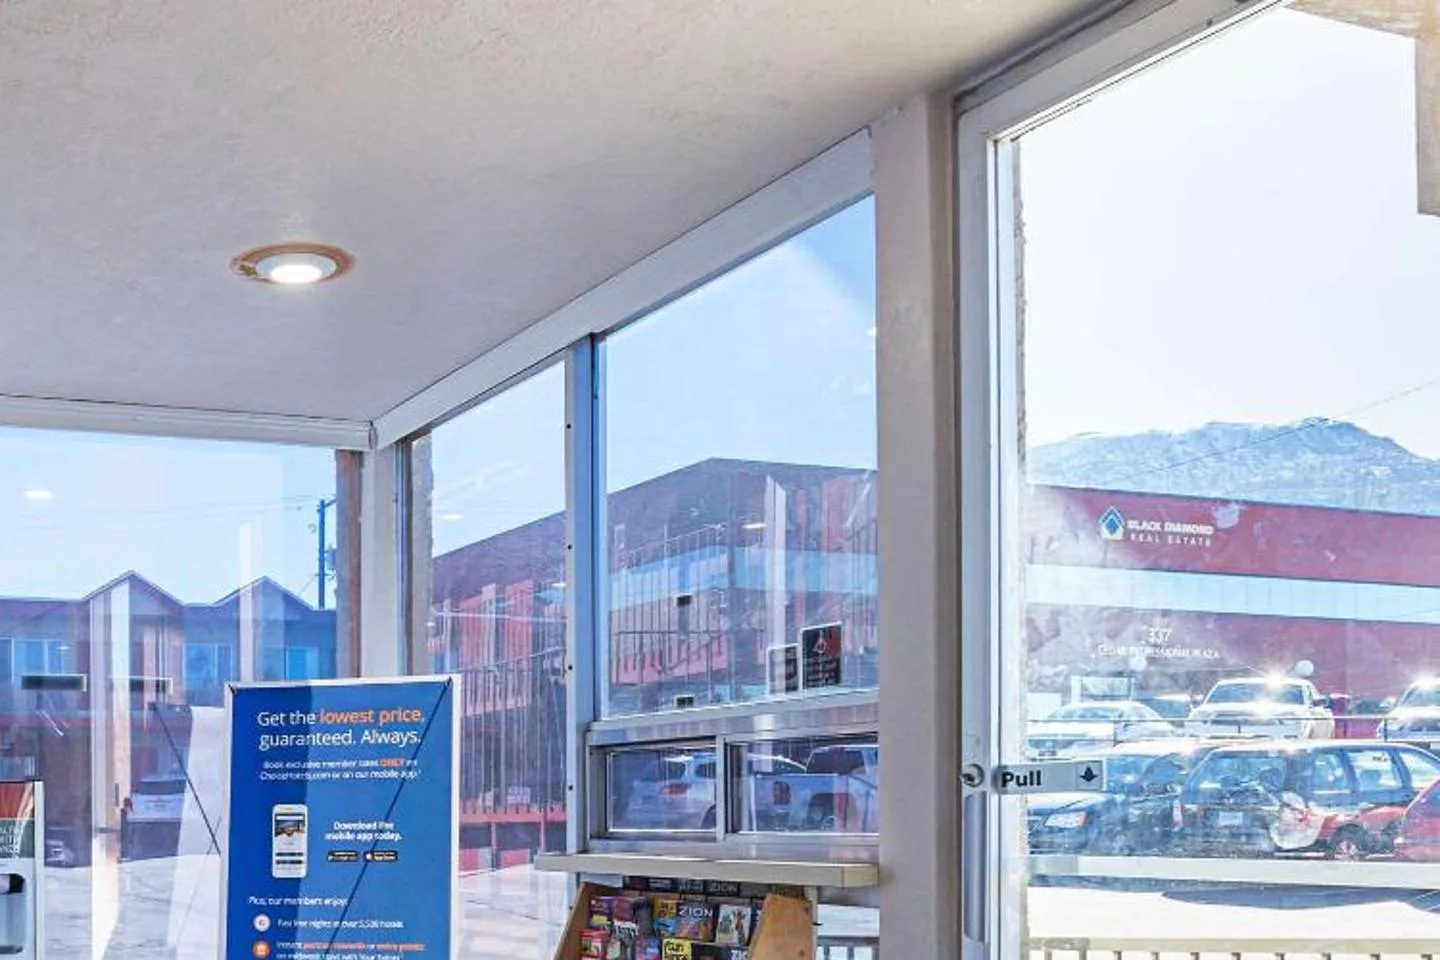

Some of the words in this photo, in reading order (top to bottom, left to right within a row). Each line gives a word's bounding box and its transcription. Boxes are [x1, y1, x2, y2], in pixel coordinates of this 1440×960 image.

[1127, 520, 1162, 531] BLACK
[1164, 522, 1214, 535] DIAMOND
[1130, 533, 1160, 544] REAL
[1168, 535, 1211, 546] ESTATE
[257, 712, 285, 726] Get
[290, 710, 316, 725] the
[319, 708, 374, 724] lowest
[258, 729, 357, 752] guaranteed.
[360, 728, 422, 748] Always.
[1002, 770, 1042, 788] Pull
[334, 821, 376, 831] Download
[324, 830, 355, 840] mobile
[356, 833, 374, 842] app
[284, 897, 323, 906] members
[679, 907, 712, 918] ZION
